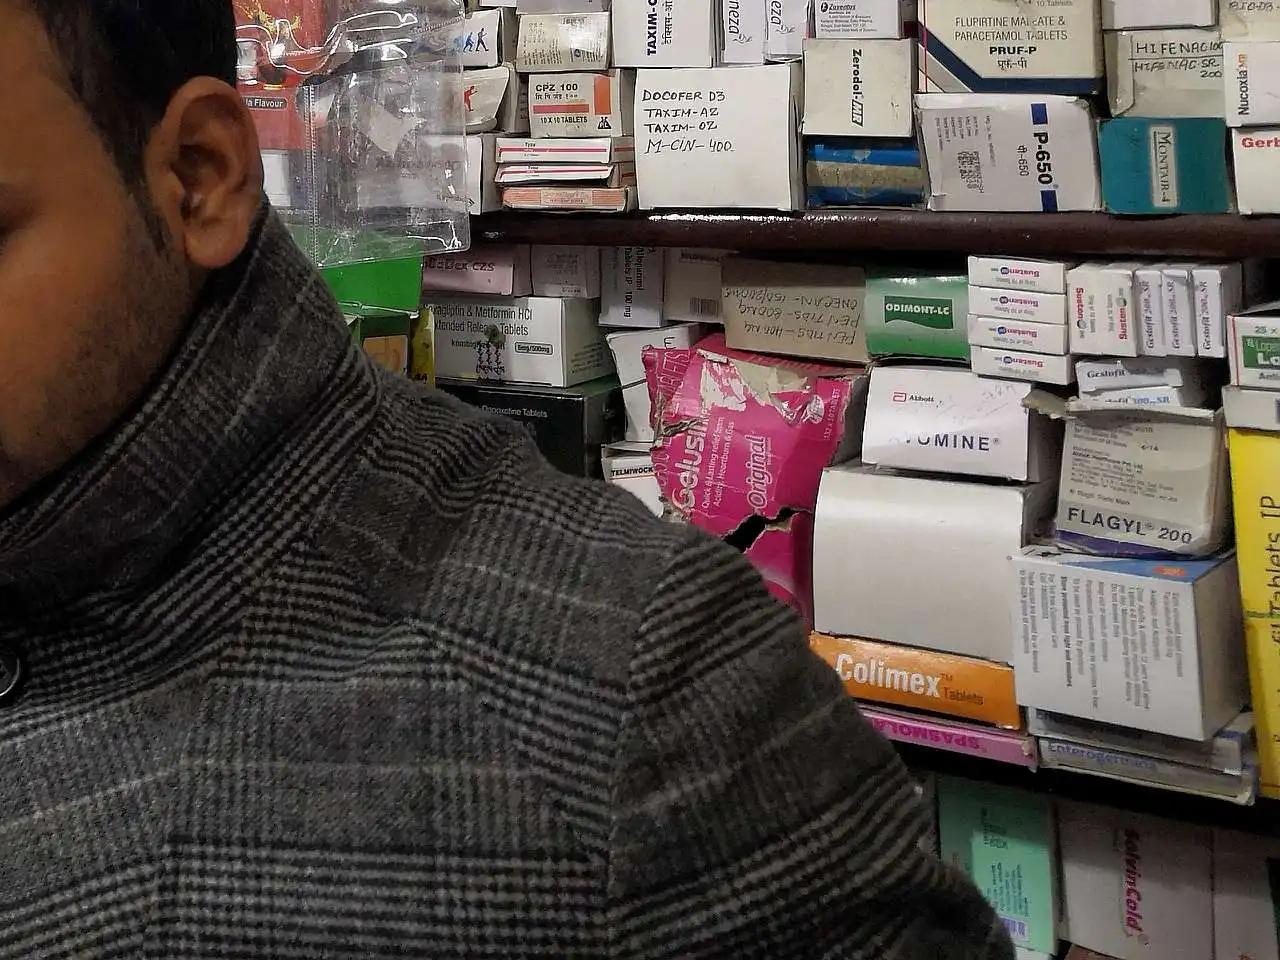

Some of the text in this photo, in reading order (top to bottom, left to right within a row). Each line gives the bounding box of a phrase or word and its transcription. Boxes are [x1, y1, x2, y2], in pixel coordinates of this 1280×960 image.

[954, 30, 1022, 42] PARACETAMOL
[989, 46, 1037, 56] PRUF-P
[535, 83, 578, 92] CPZ 100
[642, 89, 726, 102] DOCOFER D3
[257, 98, 283, 108] Flavour
[1034, 132, 1054, 186] P-650
[476, 308, 516, 321] Metformin
[886, 303, 950, 315] ODIMONT-LC
[745, 435, 766, 509] Original
[1068, 507, 1193, 544] FLAGYL 200
[835, 653, 940, 699] Colimex
